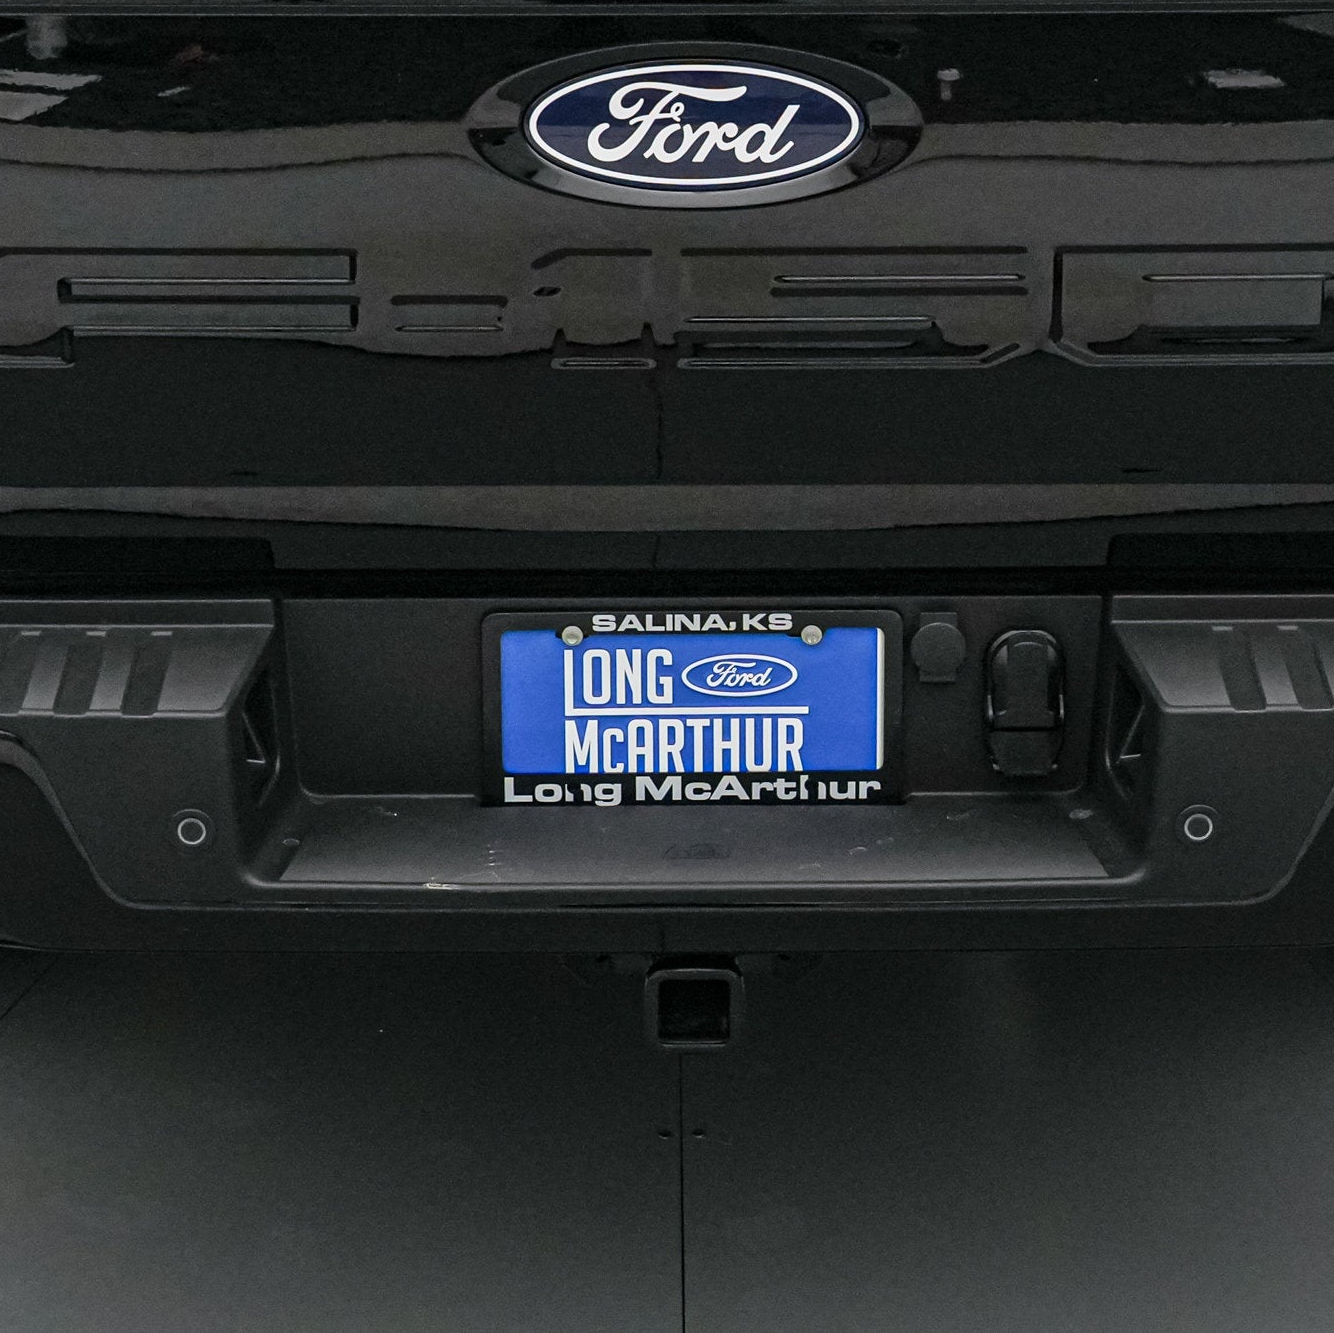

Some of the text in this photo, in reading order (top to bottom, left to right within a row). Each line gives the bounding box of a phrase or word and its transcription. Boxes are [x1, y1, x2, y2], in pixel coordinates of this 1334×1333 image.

[587, 81, 800, 164] Ford
[592, 613, 793, 632] SALINA, KS
[564, 648, 673, 716] LONG
[706, 661, 773, 687] Ford
[565, 718, 804, 773] McARTHUR
[503, 774, 881, 806] Long McArthur
